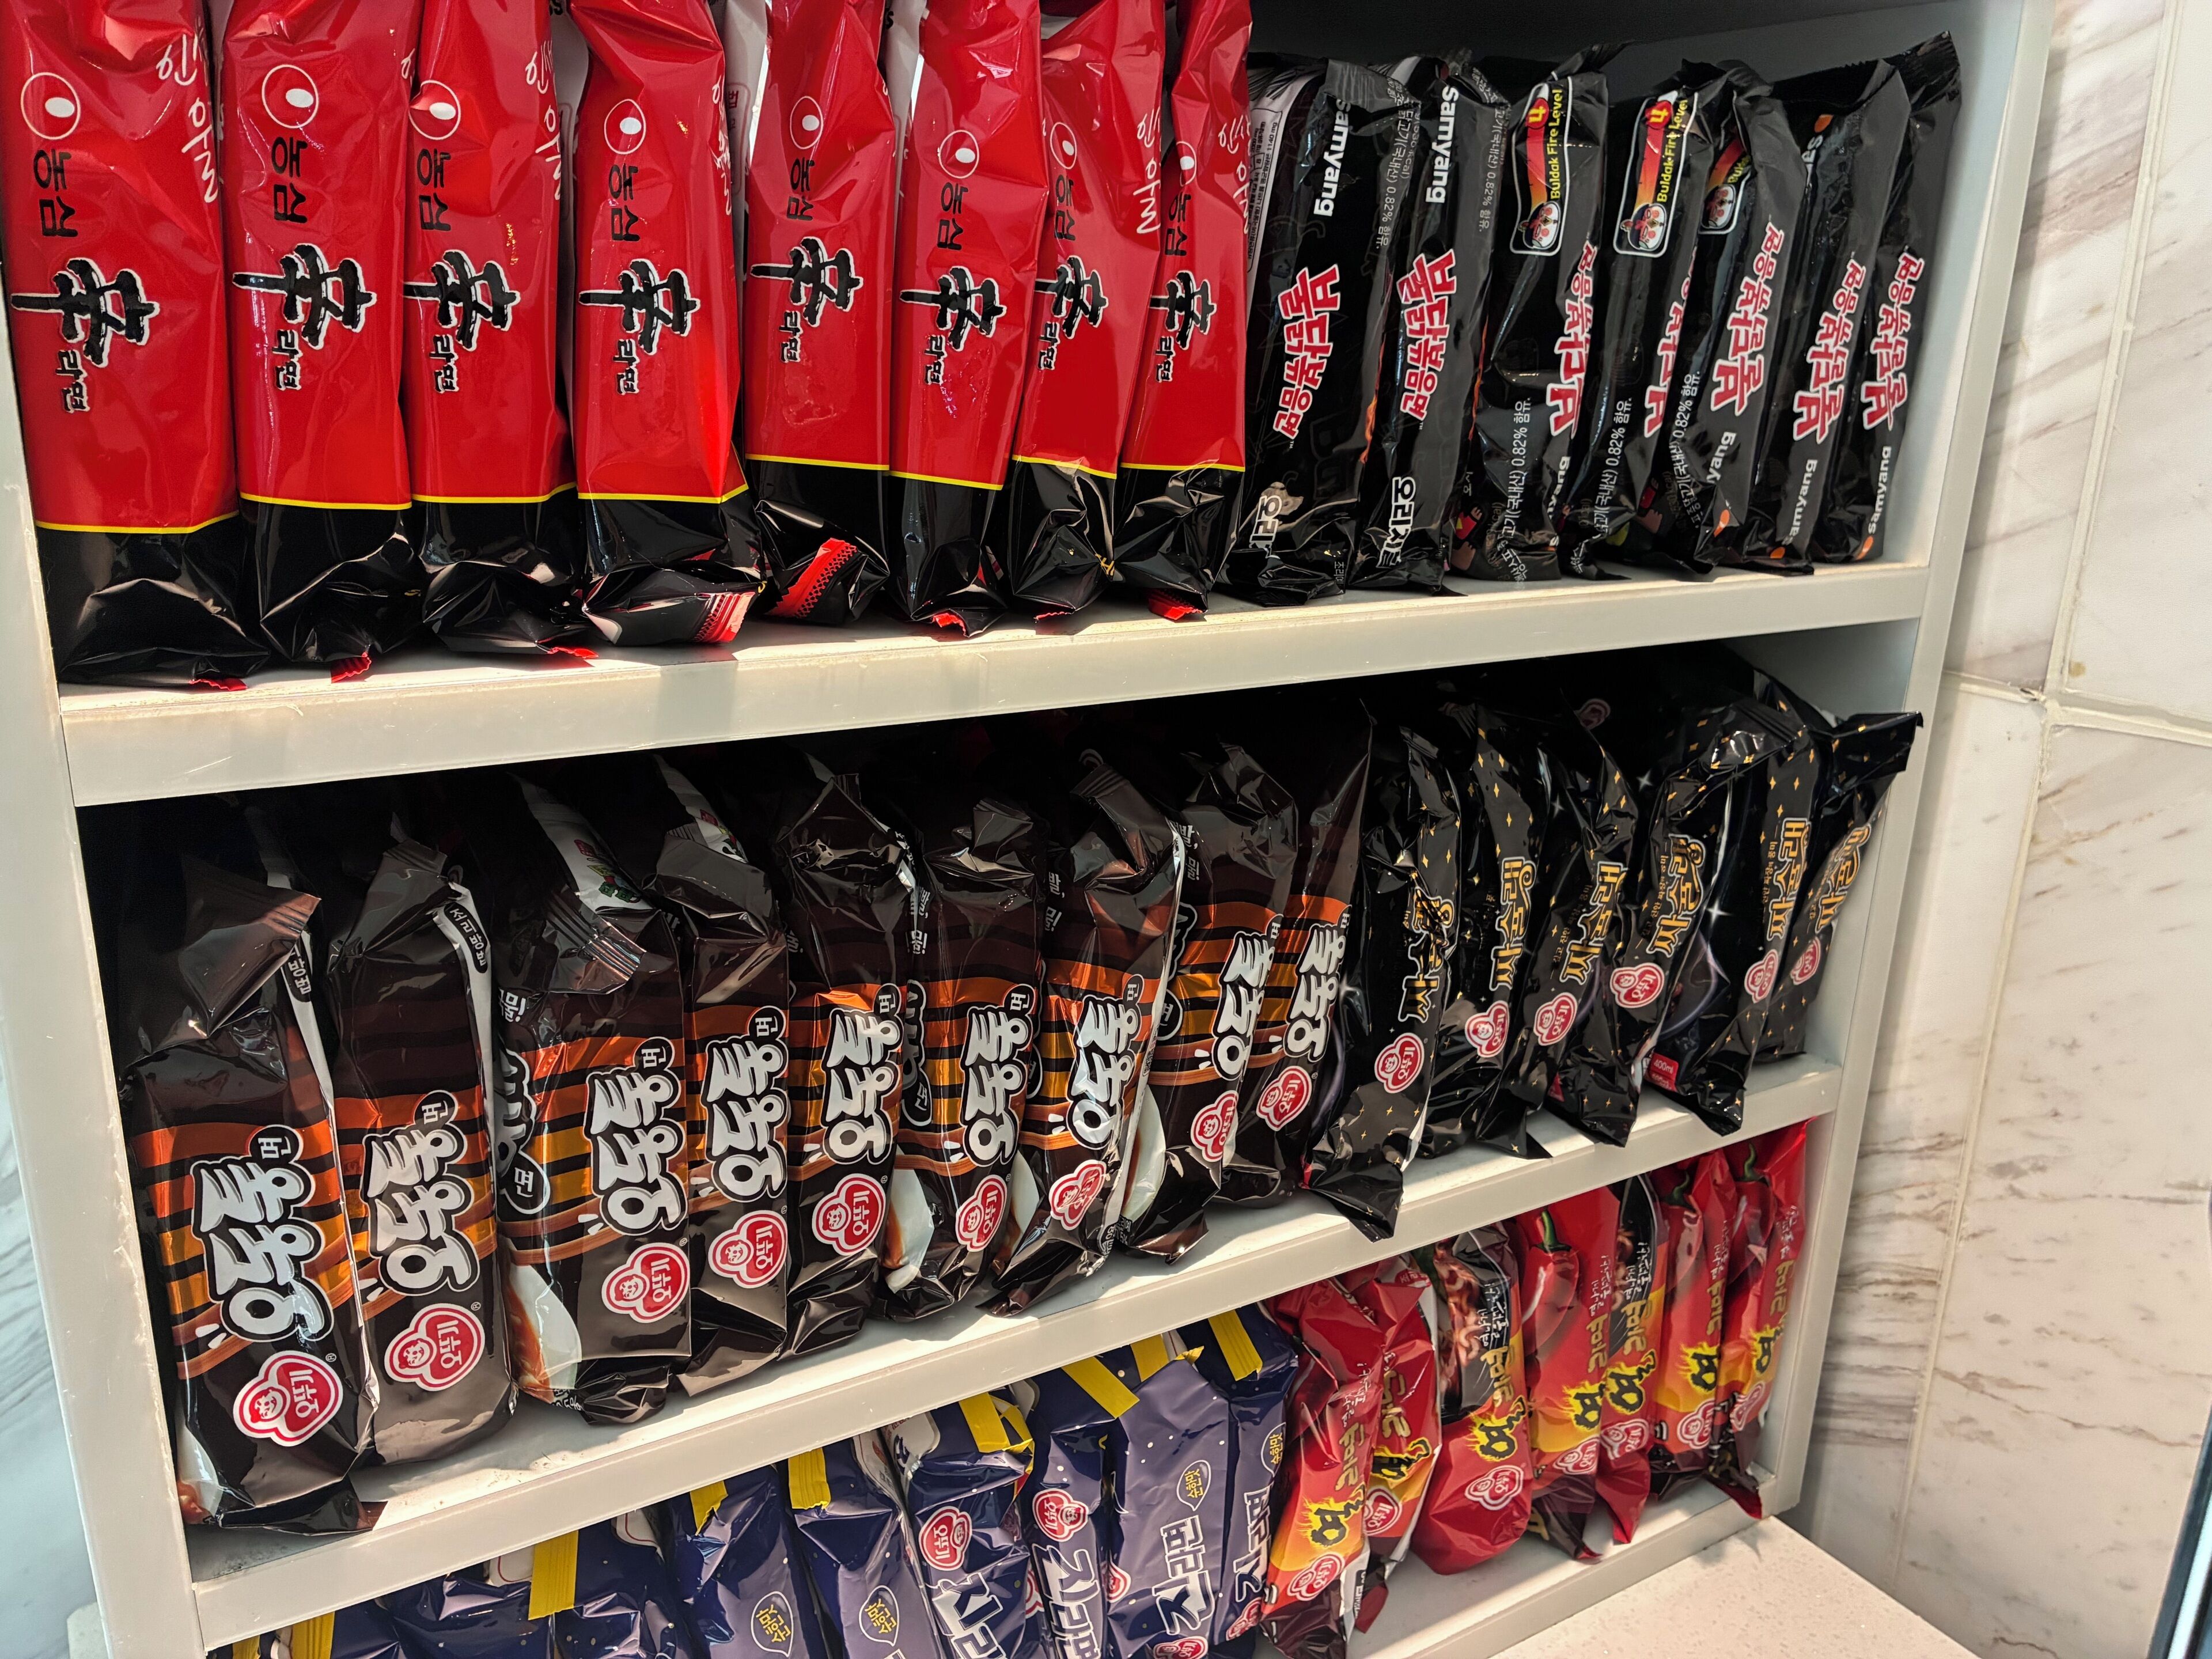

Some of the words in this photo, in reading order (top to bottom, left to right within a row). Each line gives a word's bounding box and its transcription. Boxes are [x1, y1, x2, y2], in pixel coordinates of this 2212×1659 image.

[1528, 105, 1547, 123] 4
[1548, 89, 1563, 127] Level
[1649, 108, 1669, 124] 4
[1668, 99, 1689, 130] Level
[1313, 99, 1351, 217] samyang
[1425, 86, 1459, 203] samyang
[1546, 129, 1559, 156] Fire
[1665, 133, 1678, 157] Fire
[33, 148, 78, 237] 농심
[271, 137, 308, 224] 농심
[416, 148, 450, 232] 농심
[786, 157, 815, 221] 농심
[1482, 172, 1495, 206] 0.82%
[1546, 157, 1561, 200] Buldak
[1657, 160, 1674, 203] Buldak
[609, 164, 640, 242] 농심
[937, 182, 968, 251] 농심
[1054, 175, 1075, 241] 농심
[1381, 187, 1397, 222] 0.82%
[1478, 209, 1491, 233] 함유.
[1164, 194, 1191, 256] 농심
[1375, 226, 1392, 250] 함유.
[1397, 253, 1457, 420] 불닭볶음면
[1711, 222, 1783, 416] 불닭볶음면
[1273, 263, 1340, 440] 불닭볶음면
[1793, 259, 1868, 444] 불닭볶음면
[1861, 252, 1925, 430] 불닭볶음면
[1680, 370, 1701, 397] 함유.
[1512, 397, 1531, 423] 함유.
[1612, 397, 1633, 423] 함유.
[1671, 400, 1692, 439] 0.82%
[1510, 427, 1529, 466] 0.82%
[1605, 427, 1626, 466] 0.82%
[1868, 445, 1892, 535] samyang
[1647, 835, 1705, 956] 짜슐랭
[1766, 819, 1810, 940] 짜슐랭
[1491, 858, 1535, 988] 짜슐랭
[1562, 863, 1626, 983] 짜슐랭
[1632, 974, 1654, 1002] 오뚜기
[1551, 1003, 1572, 1036] 오뚜기
[1397, 1044, 1416, 1078] 오뚜기
[1278, 1078, 1301, 1113] 오뚜기
[853, 1190, 871, 1236] 오뚜기
[982, 1190, 999, 1235] 오뚜기
[756, 1224, 773, 1269] 오뚜기
[651, 1258, 672, 1303] 오뚜기
[439, 1320, 462, 1369] 오뚜기
[291, 1370, 320, 1418] 오뚜기
[1268, 1432, 1284, 1467] 순한맛
[1184, 1467, 1204, 1499] 순한맛
[1494, 1469, 1513, 1495] 오뚜기
[1043, 1499, 1061, 1531] 오뚜기
[933, 1524, 951, 1560] 오뚜기
[1152, 1515, 1216, 1635] 진라면
[1313, 1559, 1338, 1589] 오뚜기
[756, 1603, 791, 1644] 순한맛
[867, 1598, 897, 1635] 순한맛
[931, 1572, 1006, 1659] 진라
